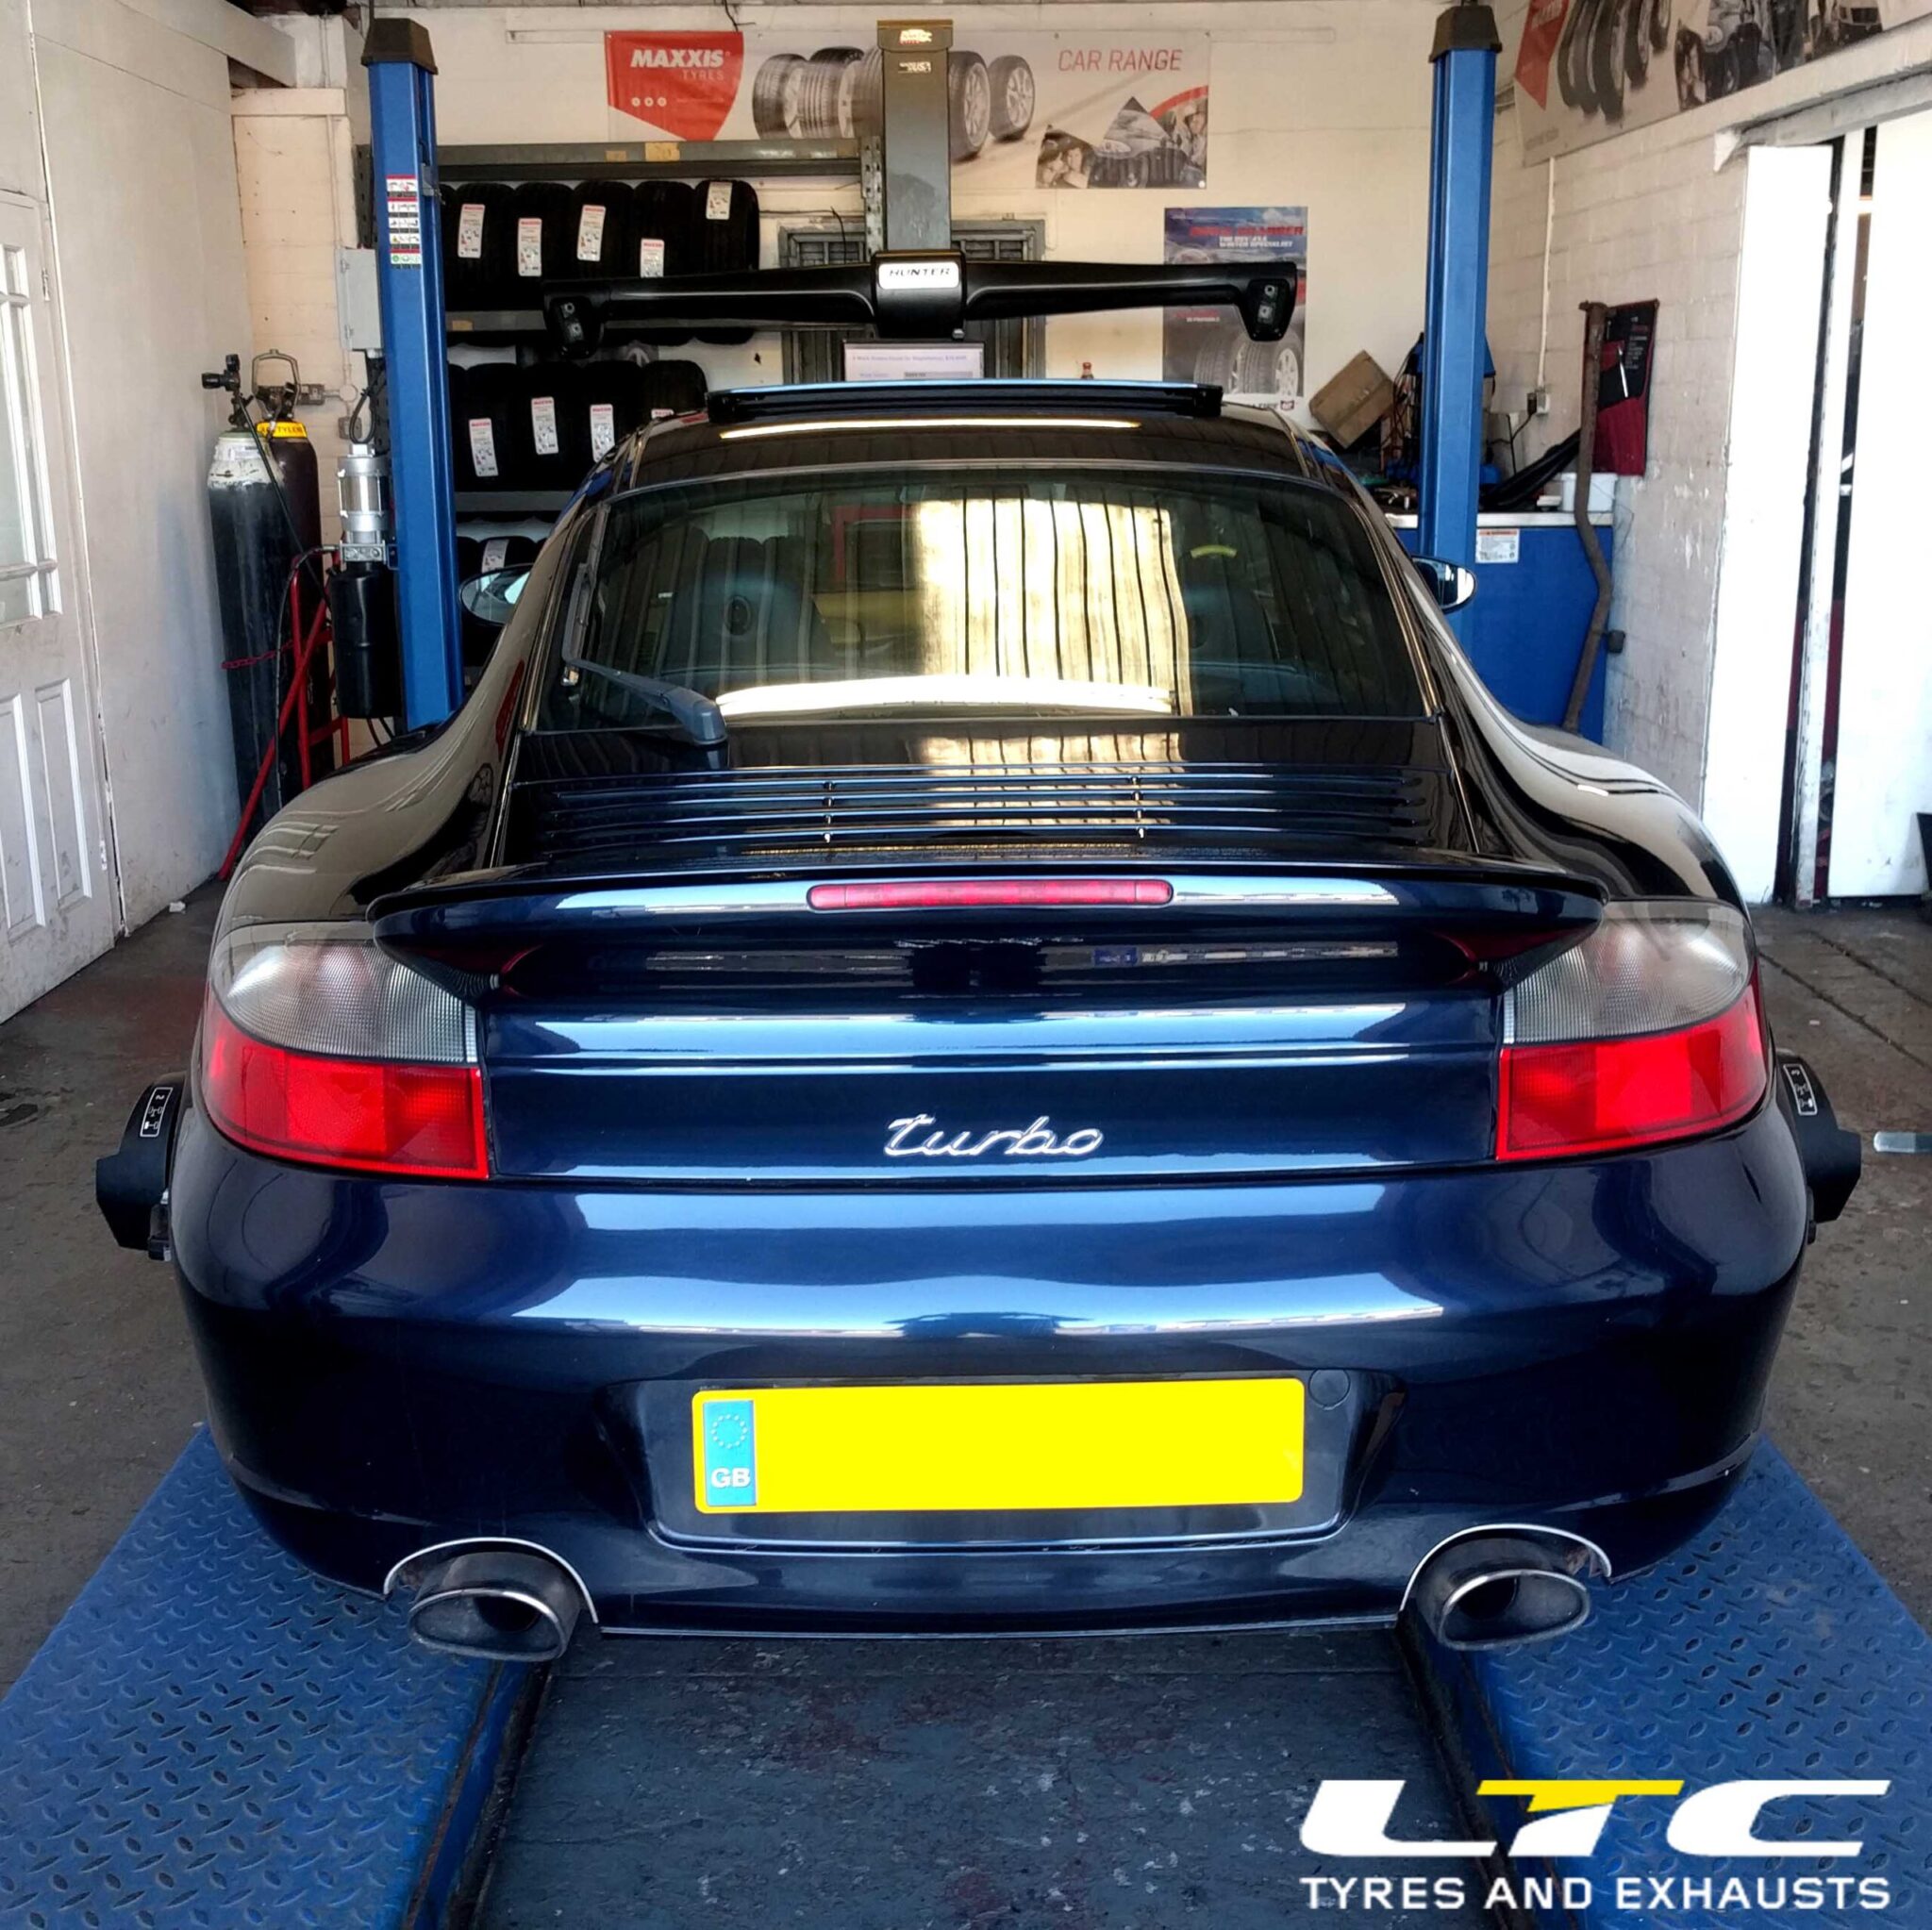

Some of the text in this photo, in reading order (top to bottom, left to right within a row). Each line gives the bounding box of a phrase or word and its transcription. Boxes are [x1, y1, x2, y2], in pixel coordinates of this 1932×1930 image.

[630, 49, 724, 68] MAXXIS
[1058, 49, 1183, 72] CAR RANGE
[682, 70, 724, 81] TYRES
[889, 267, 951, 277] HUNTER
[883, 1113, 1104, 1156] turbo
[710, 1467, 751, 1489] GB
